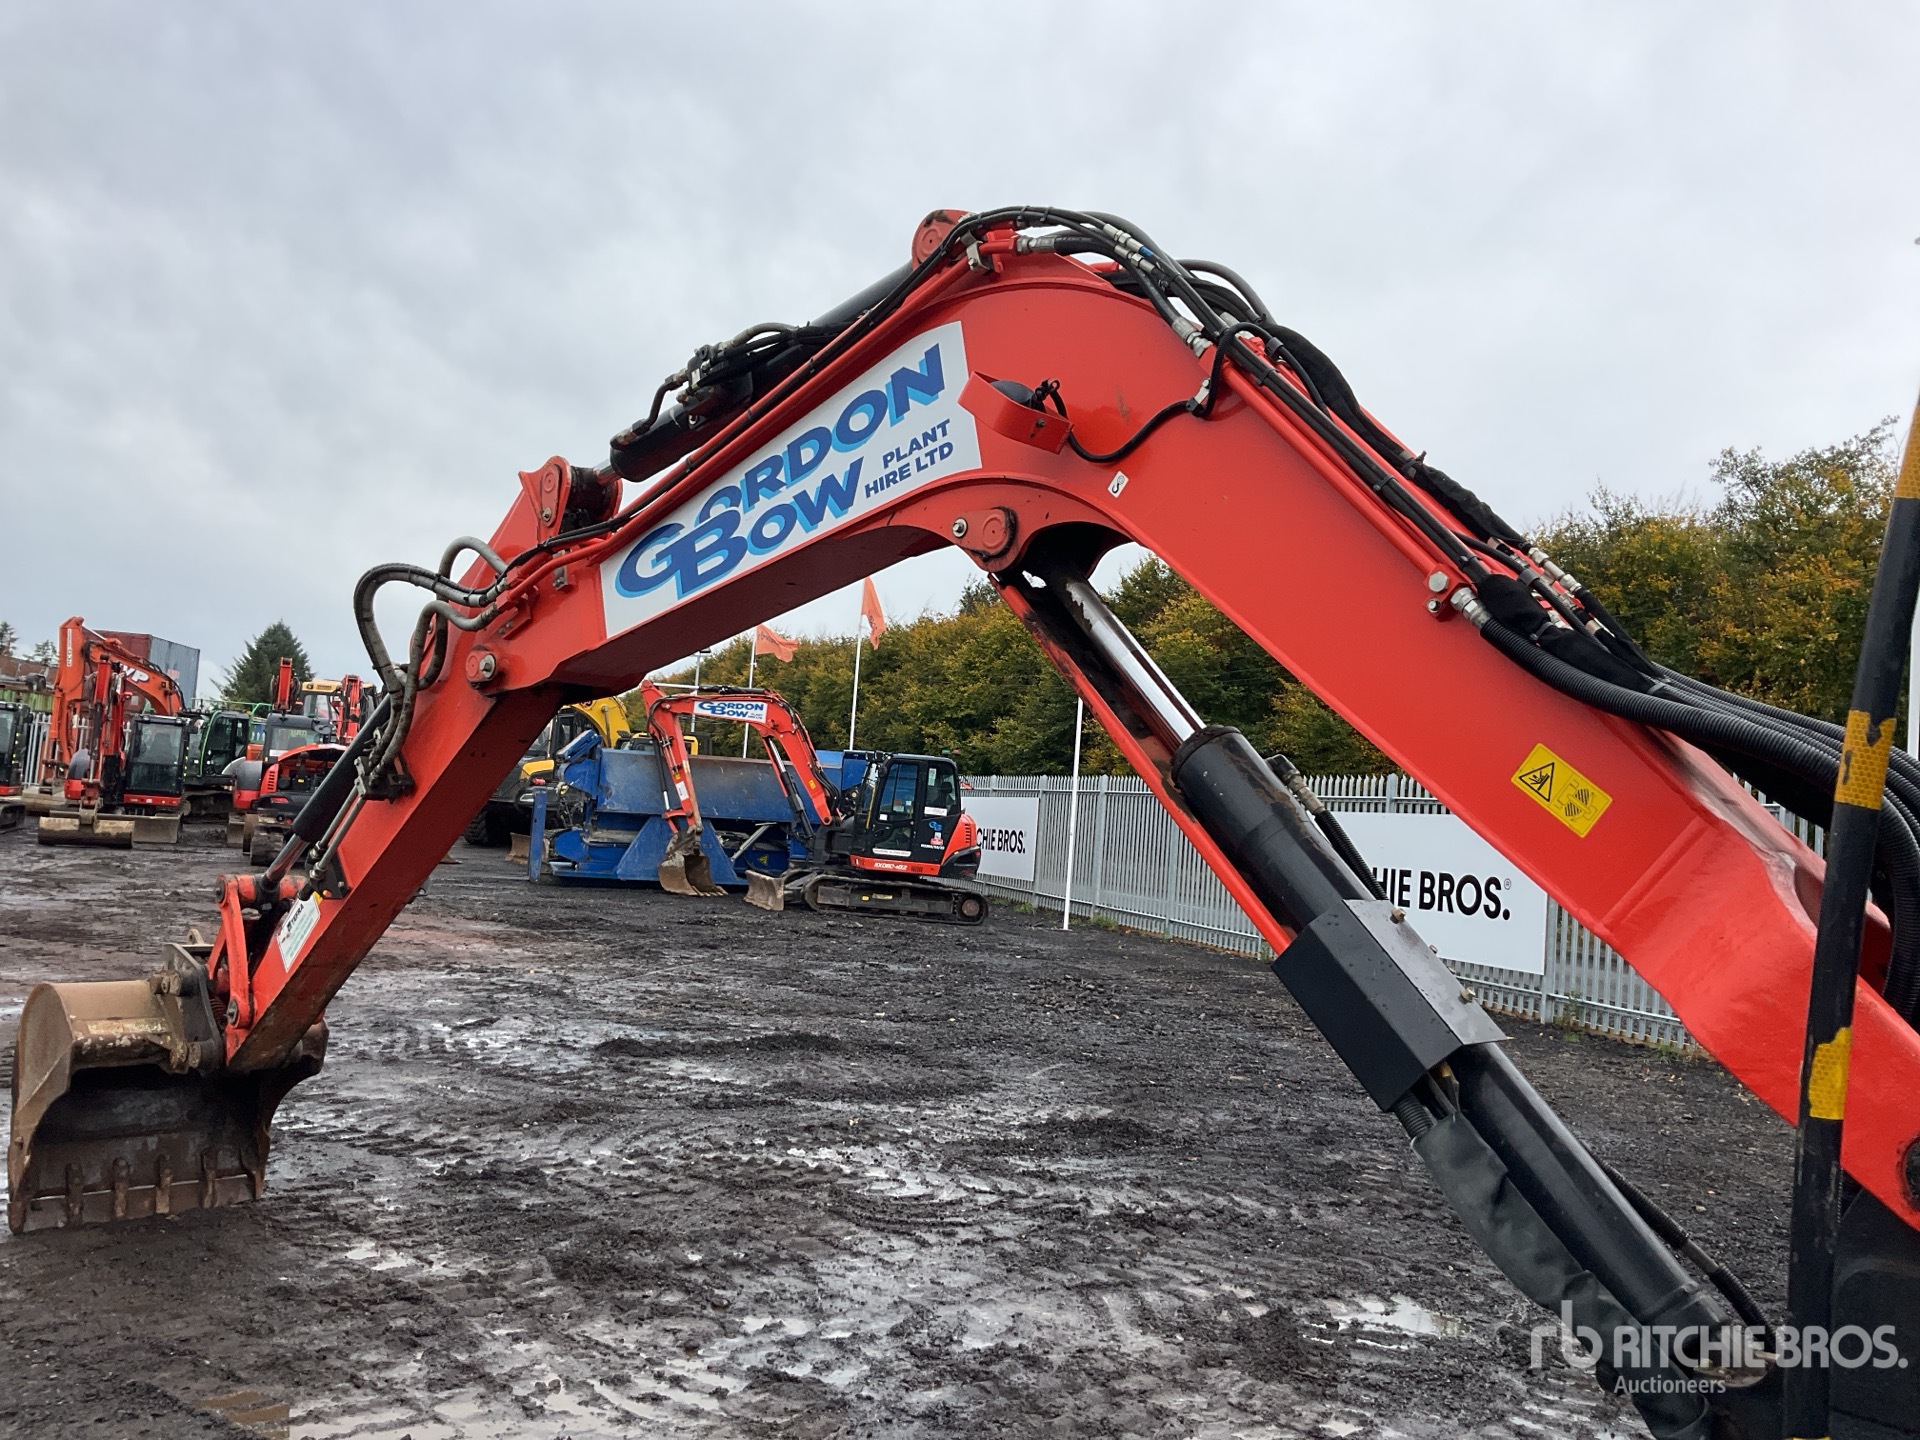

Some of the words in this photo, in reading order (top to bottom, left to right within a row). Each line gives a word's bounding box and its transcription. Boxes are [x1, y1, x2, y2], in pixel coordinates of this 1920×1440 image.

[864, 462, 912, 498] HIRE
[915, 441, 954, 473] LTD
[882, 418, 951, 469] PLANT
[615, 343, 946, 599] GORDON
[656, 456, 865, 600] BOW
[698, 701, 764, 711] GORDON
[708, 705, 749, 717] BOW
